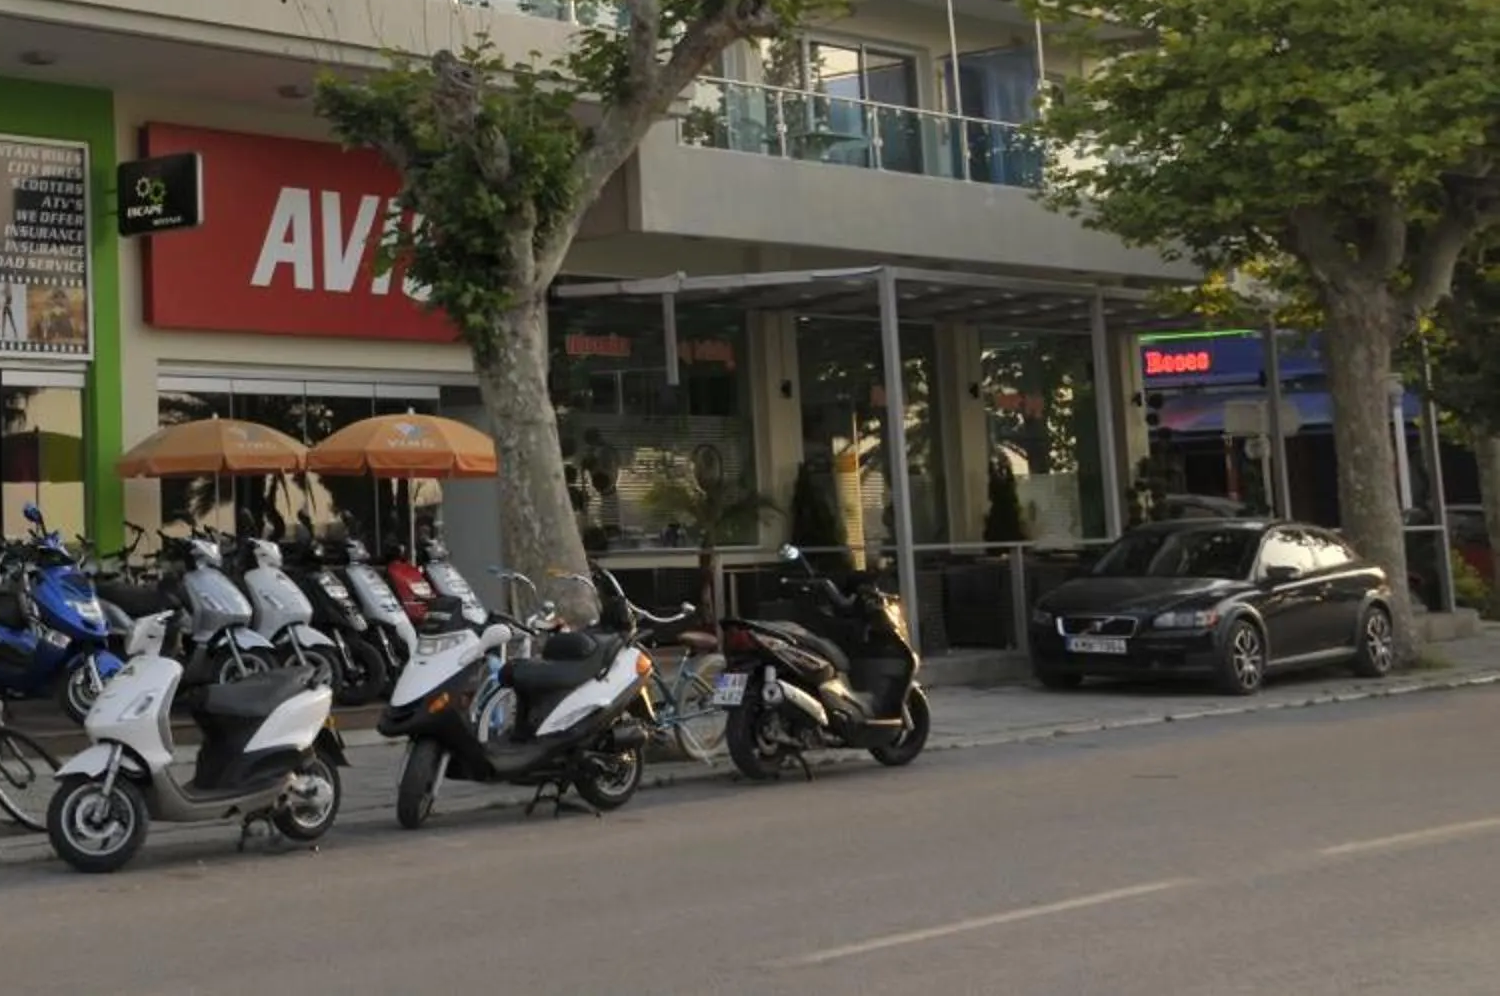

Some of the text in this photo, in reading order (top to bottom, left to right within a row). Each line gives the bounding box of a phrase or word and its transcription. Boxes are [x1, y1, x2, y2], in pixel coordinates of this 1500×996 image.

[8, 161, 38, 174] CITY
[11, 177, 83, 195] SCOOTERS
[16, 209, 83, 225] WE OFFER
[4, 224, 83, 242] INSURANCE
[4, 240, 83, 257] INSURANCE
[27, 258, 84, 273] SERVICE
